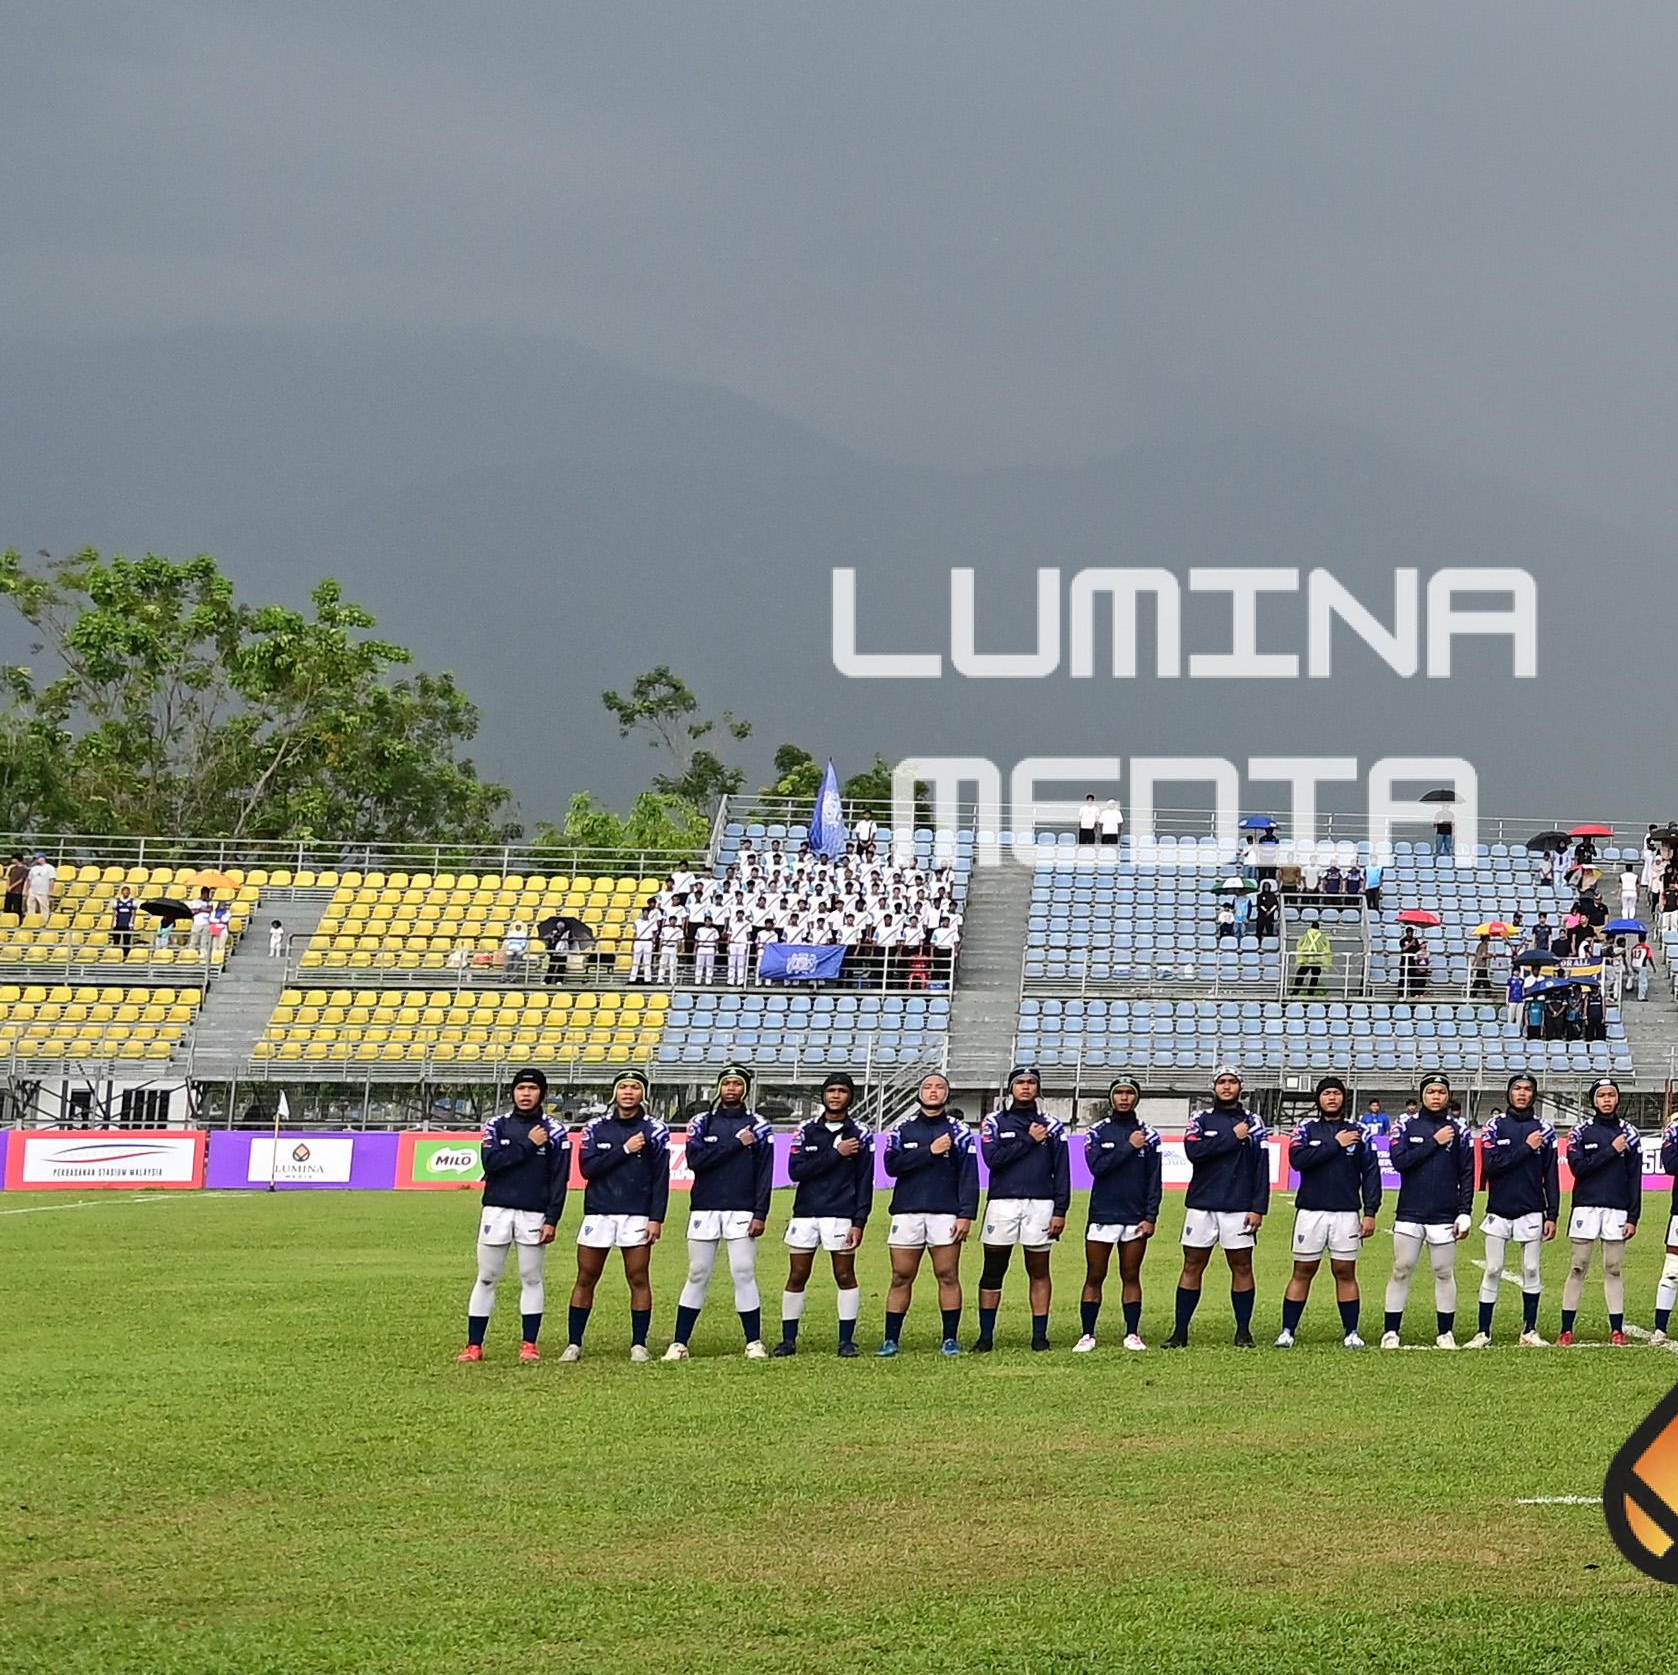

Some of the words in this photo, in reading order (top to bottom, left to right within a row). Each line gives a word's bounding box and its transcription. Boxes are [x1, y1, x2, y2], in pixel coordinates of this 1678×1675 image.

[435, 1155, 472, 1166] MILO
[129, 1168, 163, 1176] MALAYSIA
[274, 1164, 325, 1174] LUMINA
